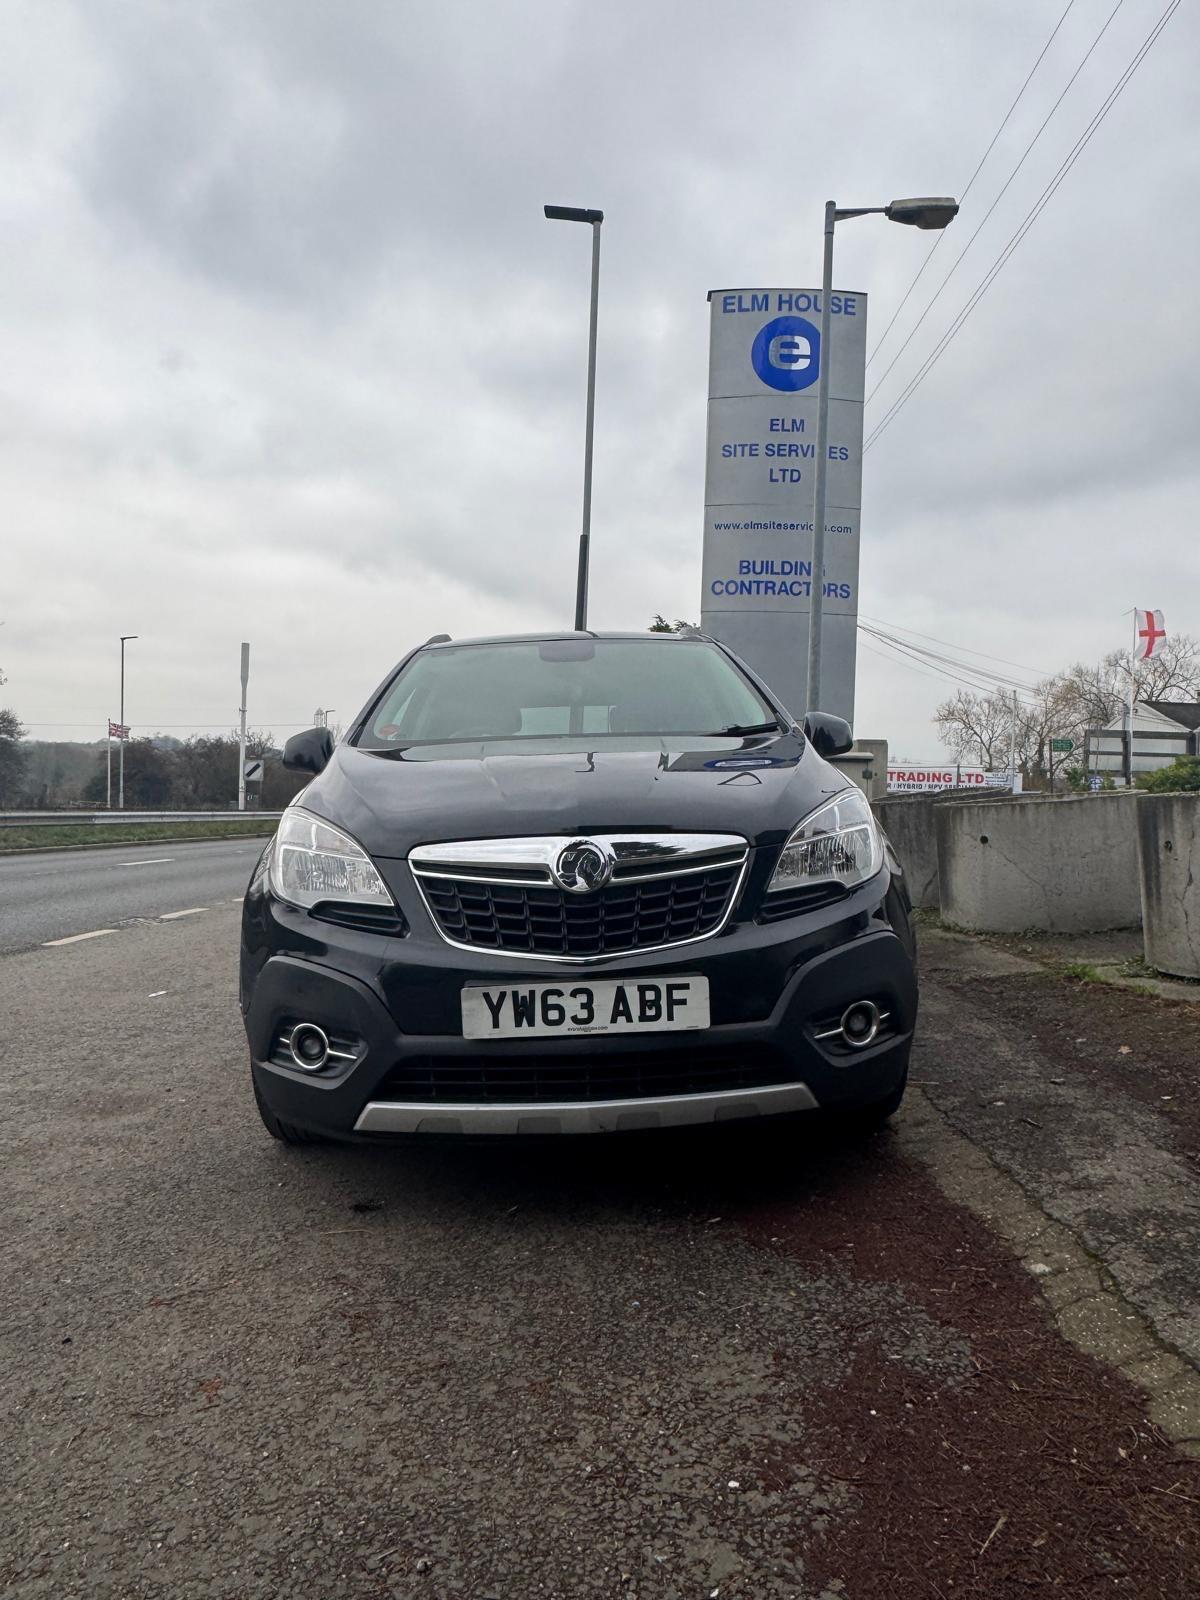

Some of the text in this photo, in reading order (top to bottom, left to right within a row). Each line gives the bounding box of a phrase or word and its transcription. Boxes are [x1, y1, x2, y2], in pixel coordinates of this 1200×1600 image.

[722, 294, 769, 314] ELM
[769, 418, 805, 432] ELM
[721, 443, 849, 460] SITE SERVIES
[769, 468, 802, 483] LTD
[714, 520, 852, 534] www.elmsiteservic.com
[739, 560, 826, 577] BUILDIN
[887, 771, 953, 783] TRADING
[957, 774, 984, 784] LTD
[482, 983, 690, 1029] YW63 ABF
